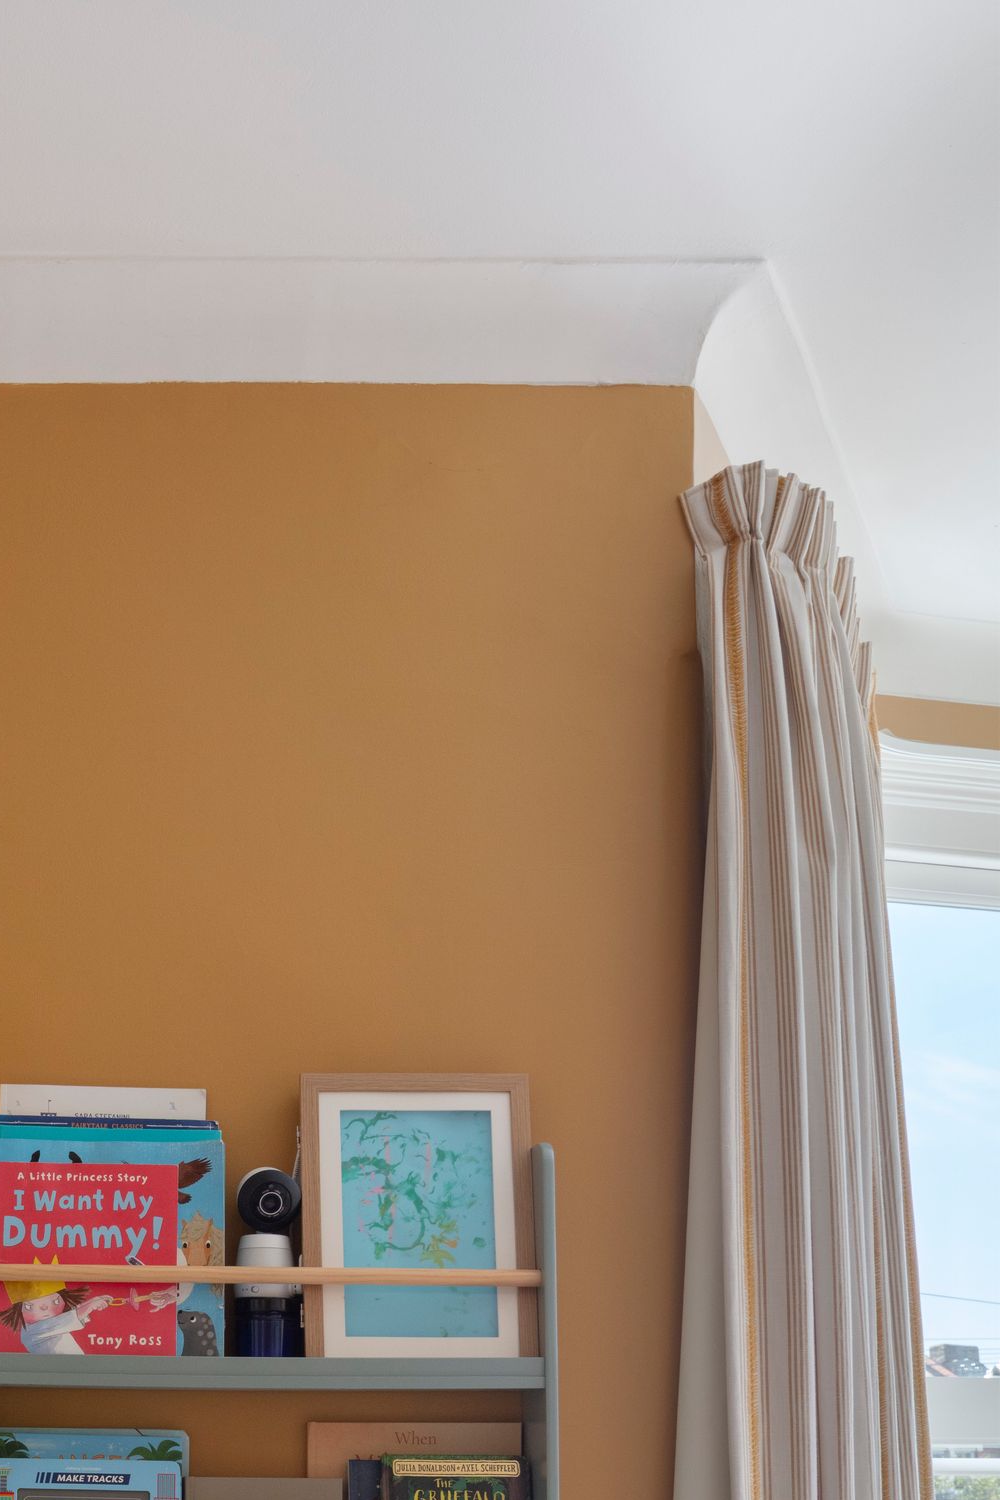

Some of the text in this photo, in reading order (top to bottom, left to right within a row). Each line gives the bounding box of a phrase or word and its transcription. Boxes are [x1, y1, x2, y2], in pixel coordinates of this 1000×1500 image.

[18, 1172, 148, 1185] A Little Princess Story
[14, 1189, 153, 1219] I Want My
[3, 1216, 163, 1261] Dummy!
[88, 1334, 162, 1349] Tony Ross
[395, 1430, 437, 1446] When
[396, 1463, 516, 1473] JULIA DONALDSON AXEL SCHEFFLER
[56, 1474, 125, 1483] MAKE TRACKS
[433, 1479, 453, 1488] THE
